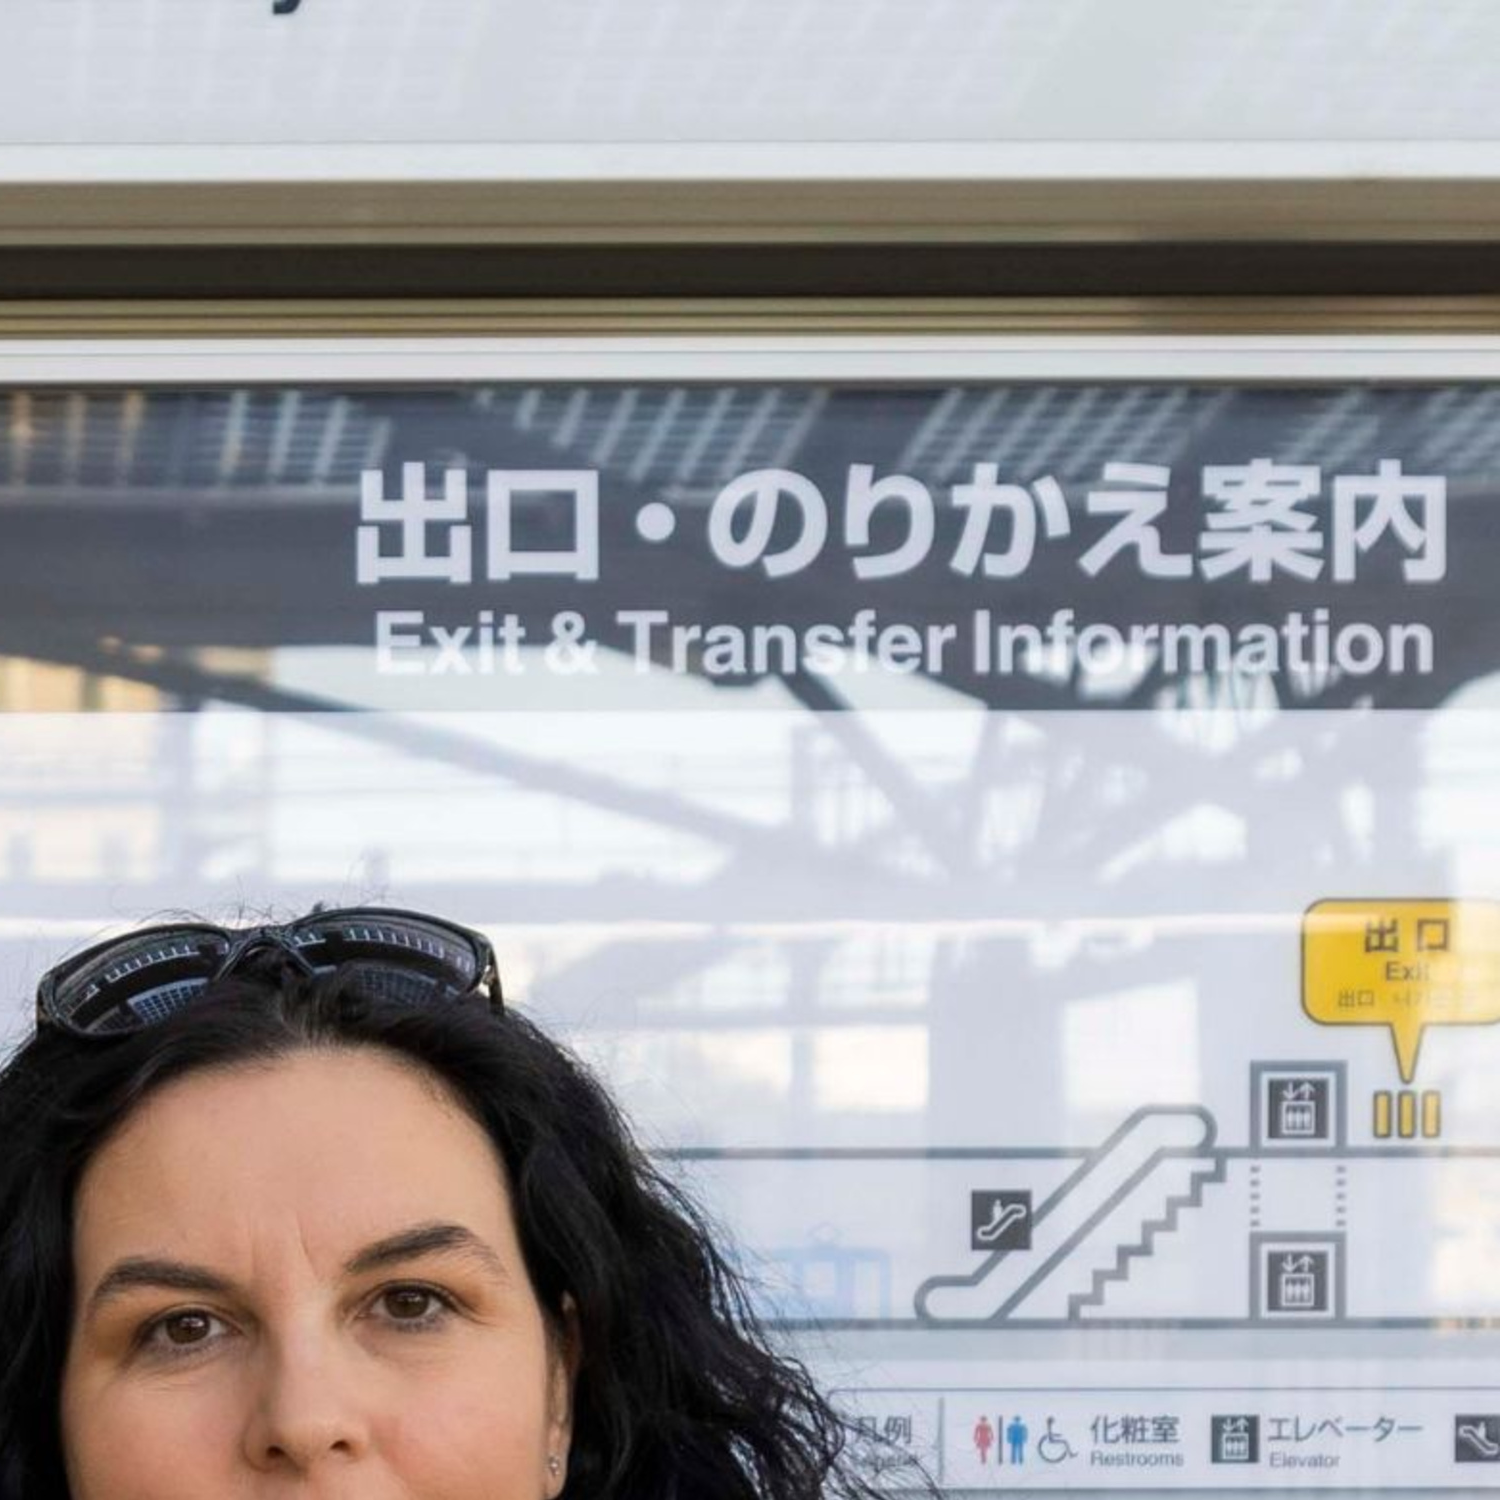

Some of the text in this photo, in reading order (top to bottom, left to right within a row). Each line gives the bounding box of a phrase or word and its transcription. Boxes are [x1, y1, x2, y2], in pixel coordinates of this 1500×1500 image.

[356, 461, 1447, 583] 出口・のりかえ案内
[375, 611, 1434, 674] Exit & Transfer Information
[1364, 918, 1449, 952] 出口
[1090, 1415, 1180, 1444] 化粧室
[1267, 1416, 1424, 1442] エレベーター
[1091, 1451, 1184, 1466] Restrooms
[1269, 1452, 1340, 1468] Elevator
